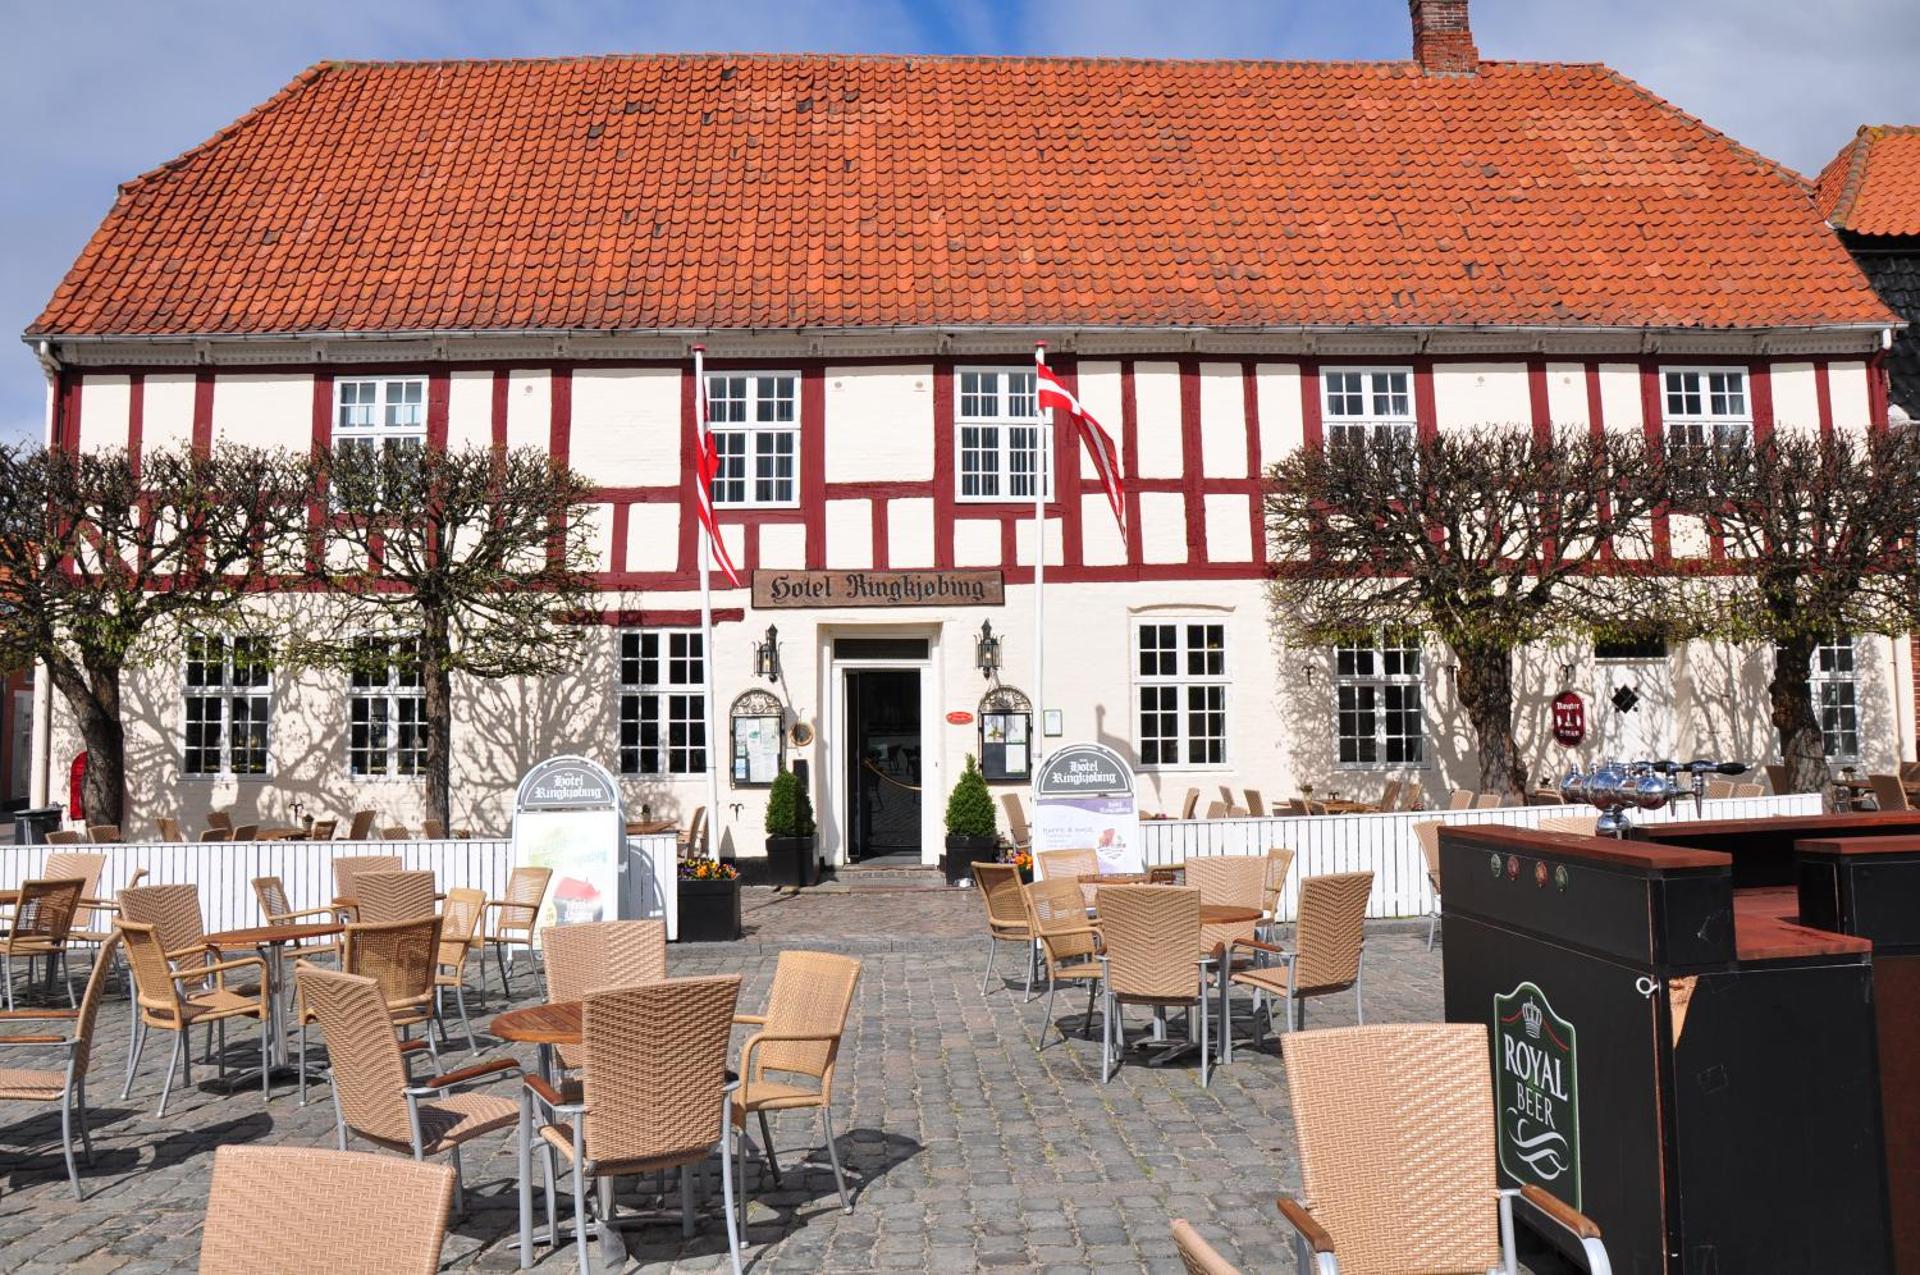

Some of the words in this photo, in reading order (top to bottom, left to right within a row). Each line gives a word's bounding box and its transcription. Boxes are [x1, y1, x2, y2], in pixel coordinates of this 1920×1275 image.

[771, 574, 833, 603] Hotel
[846, 574, 986, 602] Ringkjøbing
[553, 774, 584, 788] Hotel
[1069, 761, 1098, 774] Hotel
[1503, 1032, 1568, 1101] ROYAL
[1516, 1082, 1556, 1130] BEER
